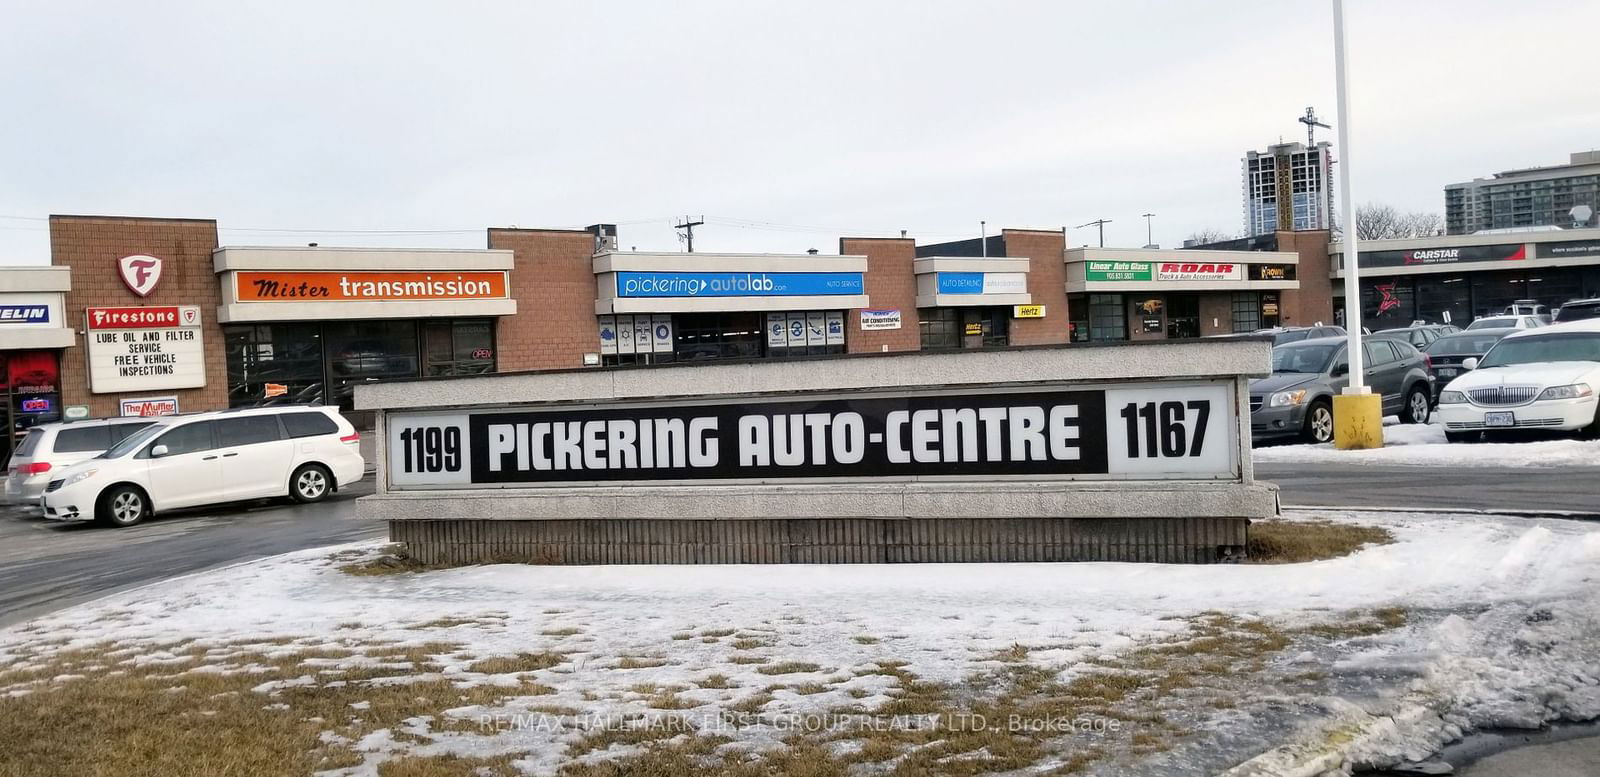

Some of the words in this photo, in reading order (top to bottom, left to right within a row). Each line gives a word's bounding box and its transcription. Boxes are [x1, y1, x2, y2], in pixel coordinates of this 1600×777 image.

[1413, 250, 1459, 259] CARSTAR
[1090, 262, 1112, 270] Linear
[1113, 262, 1130, 270] Auto
[1161, 264, 1234, 273] ROAR
[253, 279, 330, 298] Mister
[338, 276, 492, 297] transmission
[625, 277, 699, 295] pickering
[826, 280, 840, 288] AUTO
[841, 280, 860, 288] SERVICE
[942, 279, 958, 288] AUTO
[0, 308, 45, 319] ELIN
[93, 309, 176, 326] Firestone
[1020, 308, 1039, 316] Hertz
[96, 333, 118, 344] LUBE
[123, 332, 137, 343] OIL
[142, 331, 160, 342] AND
[165, 330, 195, 341] FILTER
[128, 343, 162, 354] SERVICE
[472, 348, 492, 360] OPEN
[114, 355, 140, 366] FREE
[143, 353, 177, 364] VEHICLE
[119, 365, 174, 377] INSPECTIONS
[125, 404, 140, 413] The
[140, 402, 175, 416] Muffler
[1119, 400, 1211, 459] 1167
[487, 416, 719, 472] PICKERING
[738, 404, 1081, 467] AUTO-CENTRE
[399, 426, 462, 474] 1199
